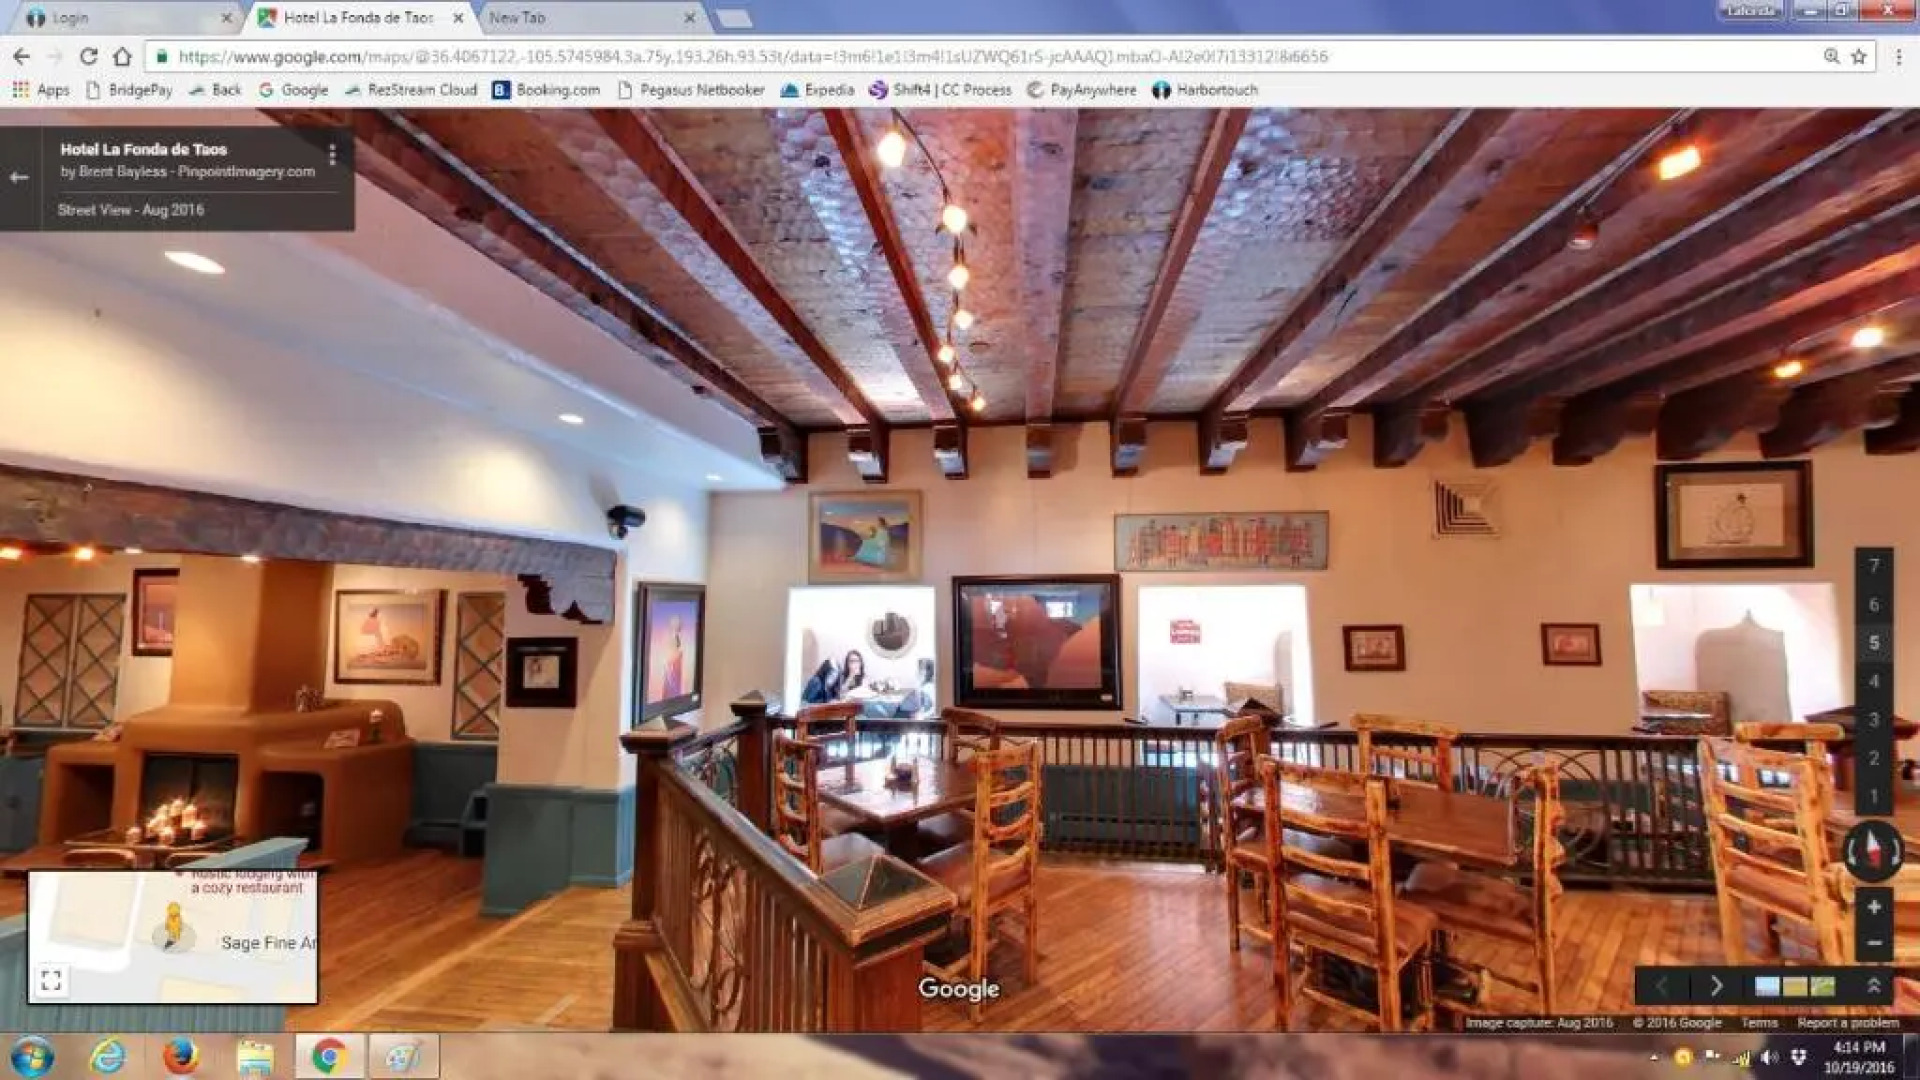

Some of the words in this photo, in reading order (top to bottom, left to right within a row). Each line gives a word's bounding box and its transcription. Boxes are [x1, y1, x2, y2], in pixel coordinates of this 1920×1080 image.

[53, 11, 89, 27] Login
[284, 10, 320, 24] Hotel
[323, 10, 338, 24] La
[341, 10, 382, 24] Fonda
[384, 10, 401, 24] de
[488, 11, 518, 24] New
[522, 10, 547, 24] Tab
[37, 83, 71, 99] Apps
[109, 83, 173, 99] BridgePay
[213, 83, 241, 97] Back
[281, 83, 329, 99] Google
[368, 83, 436, 97] RezStream
[440, 83, 478, 97] Cloud
[517, 83, 601, 100] Booking.com
[640, 83, 693, 99] Pegasus
[697, 83, 766, 97] Netbooker
[805, 83, 856, 99] Expedia
[893, 82, 931, 97] Shift4
[942, 83, 960, 97] CC
[963, 83, 1013, 97] Process
[1051, 83, 1138, 100] PayAnywhere
[1177, 83, 1259, 97] Harbortouch
[60, 142, 100, 157] Hotel
[102, 142, 121, 157] La
[123, 142, 168, 157] Fonda
[171, 142, 190, 157] de
[192, 142, 228, 157] Taos
[60, 164, 77, 181] by
[78, 164, 115, 178] Brent
[117, 164, 168, 180] Bayless
[177, 164, 316, 181] PinpointImagery.com
[57, 203, 97, 217] Street
[99, 203, 132, 217] View
[141, 203, 169, 220] Aug
[171, 203, 205, 217] 2016
[1868, 557, 1880, 574] 7
[1868, 598, 1880, 615] 6
[1868, 634, 1880, 651] 5
[1868, 672, 1880, 689] 4
[1868, 711, 1880, 728] 3
[1868, 749, 1880, 766] 2
[1868, 788, 1880, 805] 1
[191, 884, 200, 894] a
[201, 884, 234, 898] cozy
[235, 882, 304, 895] restaurant
[222, 935, 261, 953] Sage
[264, 935, 297, 950] Fine
[918, 976, 1000, 1003] Google
[1465, 1016, 1505, 1031] Image
[1505, 1016, 1554, 1031] capture:
[1557, 1016, 1582, 1031] Aug
[1584, 1016, 1615, 1029] 2016
[1647, 1016, 1677, 1029] 2016
[1679, 1016, 1723, 1031] Google
[1741, 1016, 1779, 1029] Terms
[1797, 1016, 1838, 1031] Report
[1840, 1018, 1848, 1029] a
[1850, 1016, 1901, 1031] problem
[1833, 1040, 1861, 1055] 4:14
[1863, 1040, 1887, 1055] PM
[1823, 1060, 1897, 1077] 10/19/2016
